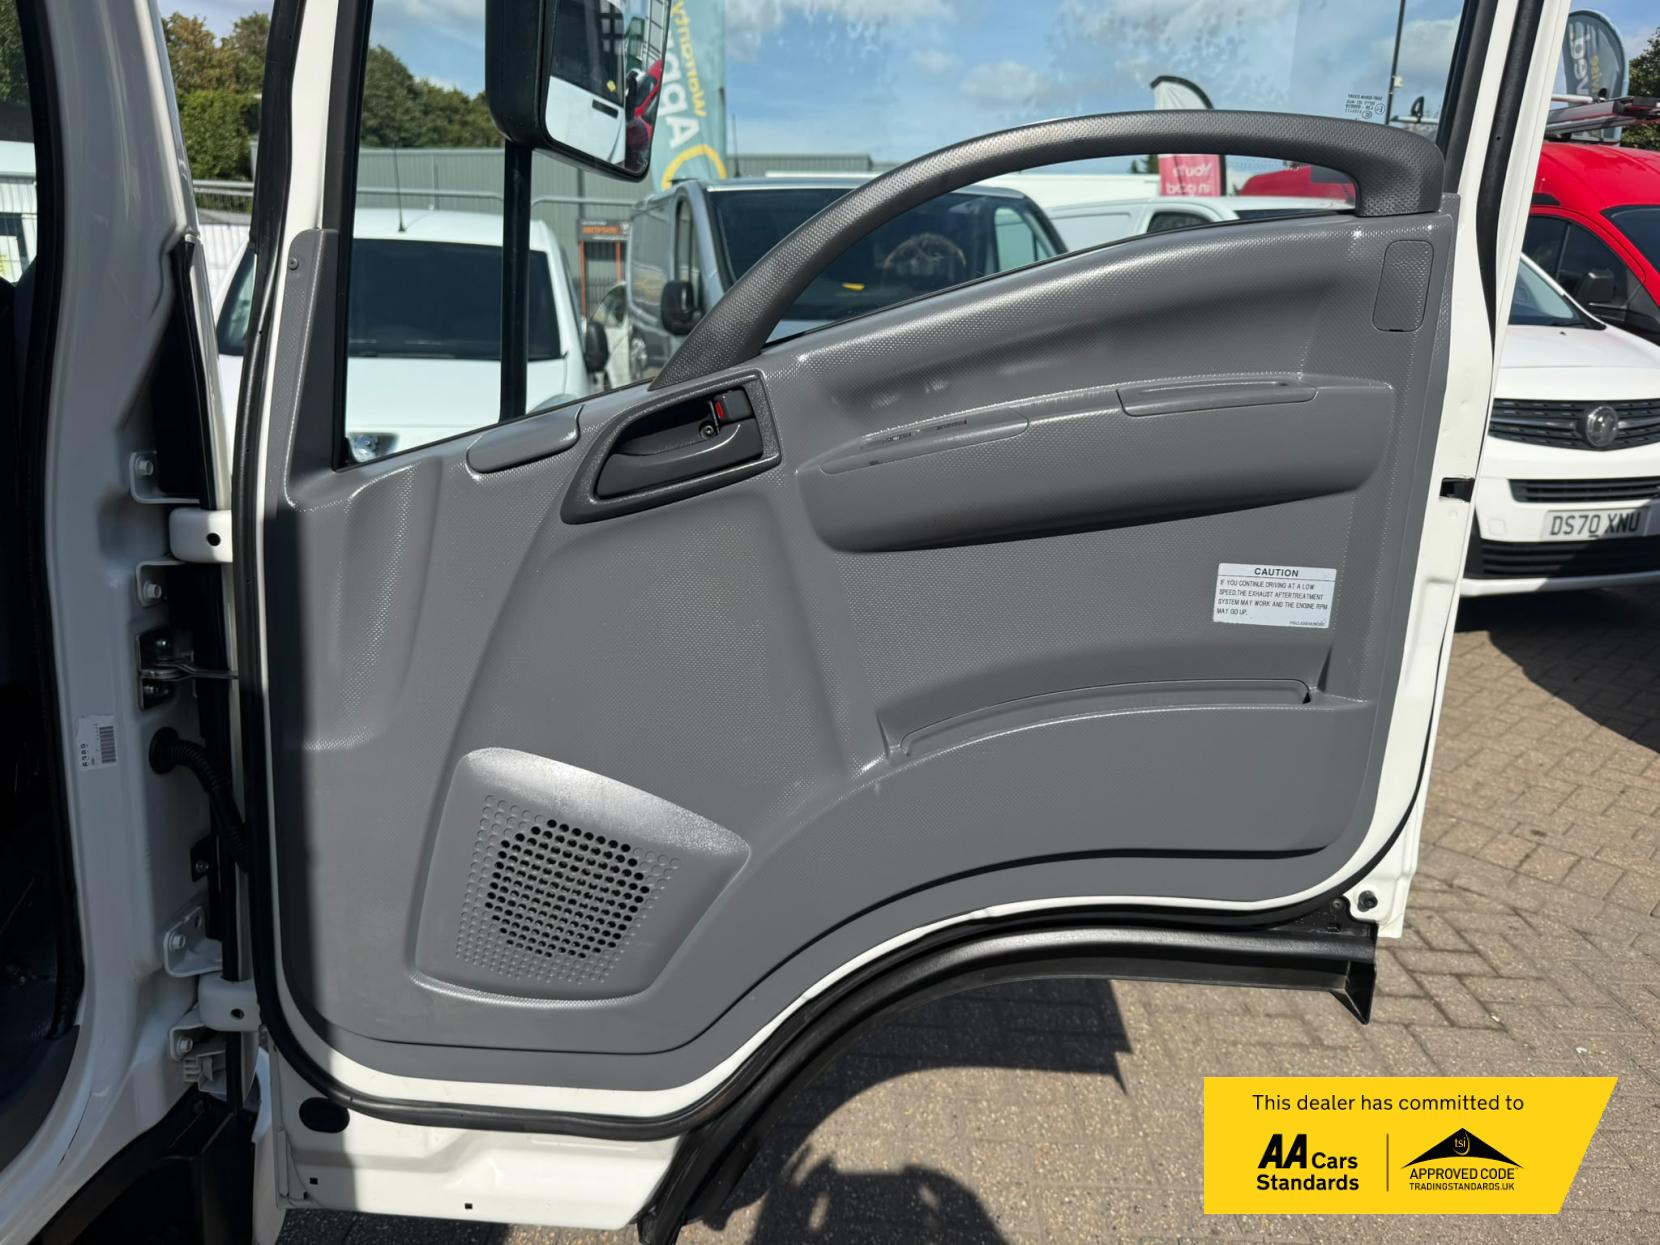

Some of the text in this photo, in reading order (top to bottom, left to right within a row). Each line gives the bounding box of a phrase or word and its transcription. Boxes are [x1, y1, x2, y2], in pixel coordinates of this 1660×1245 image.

[1550, 511, 1642, 536] DS70 XNU
[1254, 567, 1299, 577] CAUTION
[1239, 580, 1264, 588] CONTINUE
[1275, 592, 1324, 600] AFTERTREATMENT
